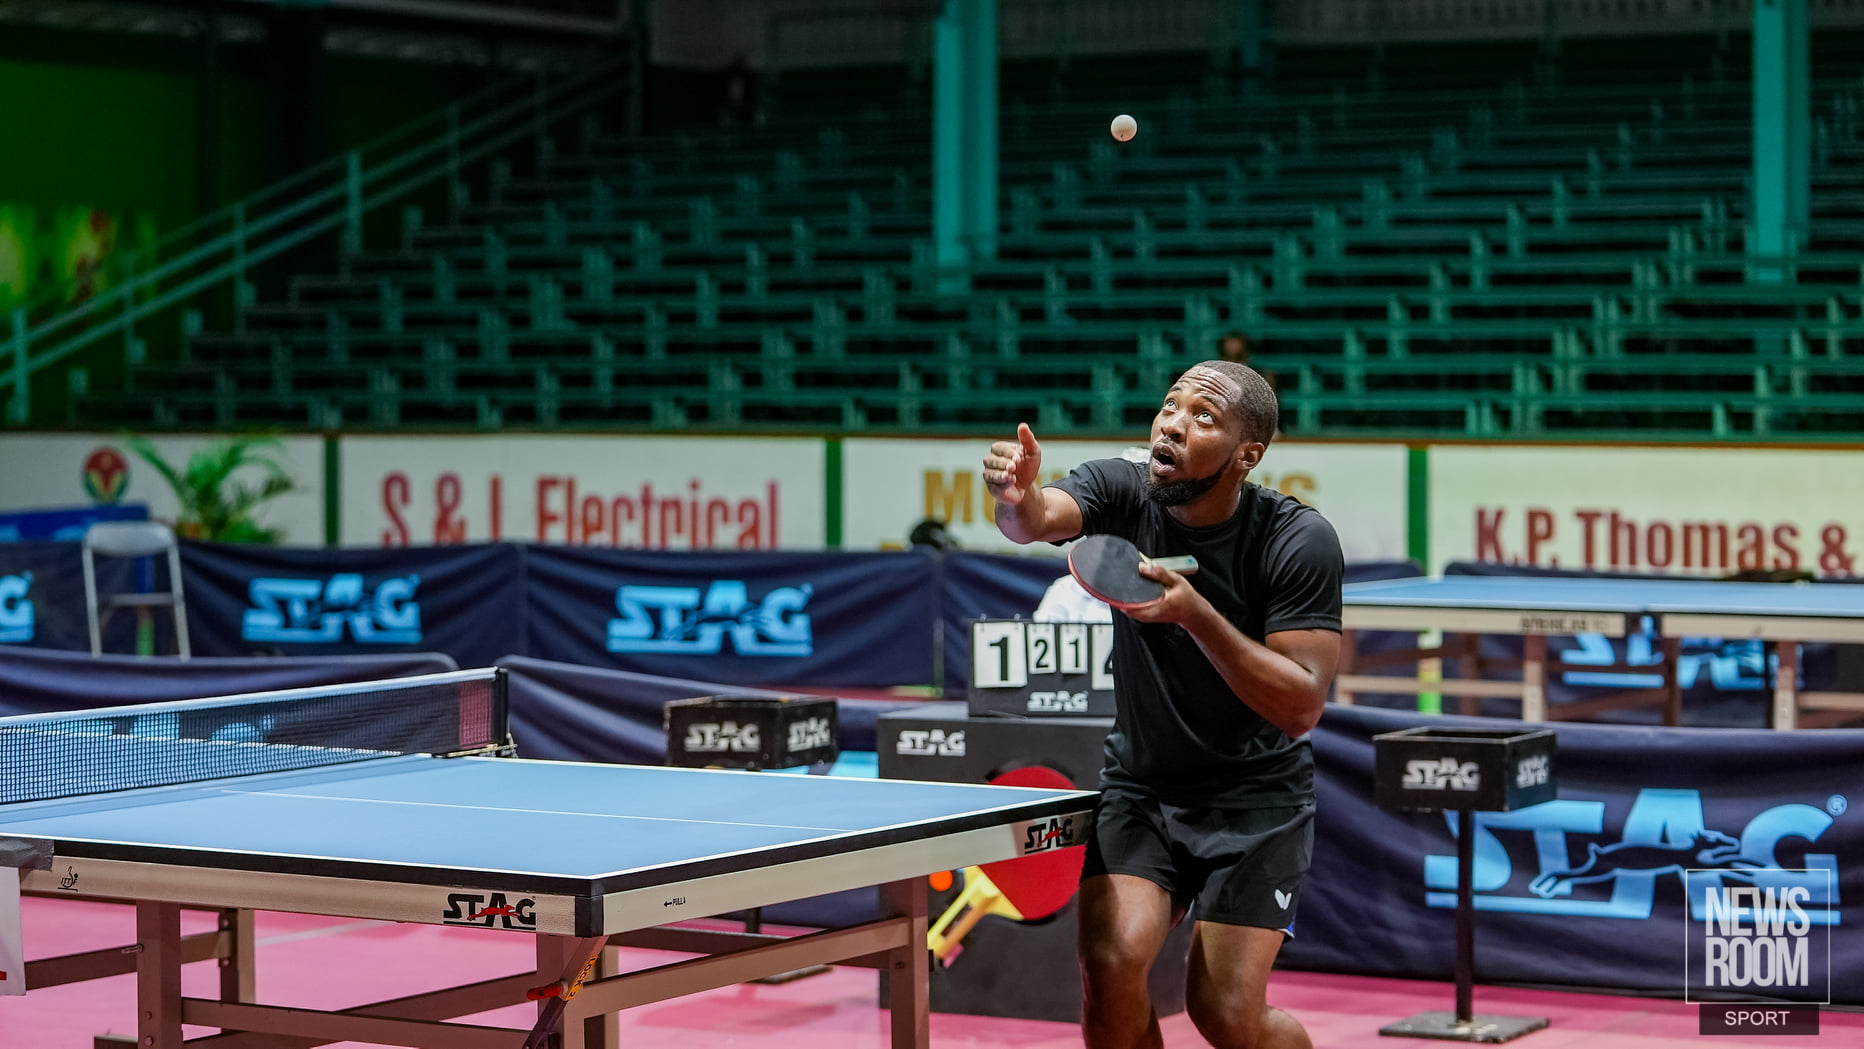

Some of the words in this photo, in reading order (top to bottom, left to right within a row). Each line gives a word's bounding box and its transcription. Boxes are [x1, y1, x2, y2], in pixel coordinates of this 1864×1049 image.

[380, 470, 411, 547] S
[434, 470, 467, 544] &
[536, 474, 779, 550] Electrical
[1575, 508, 1801, 571] Thomas
[1818, 522, 1855, 577] &
[242, 573, 422, 643] STAG
[607, 580, 813, 656] STAG
[989, 637, 1008, 681] 1
[1034, 639, 1049, 668] 2
[1068, 638, 1079, 668] 1
[1027, 691, 1088, 712] STAG
[684, 720, 760, 752] STAG
[896, 729, 965, 756] STAG
[1402, 757, 1480, 791] STAG
[1024, 817, 1074, 854] STAG
[443, 892, 537, 930] STAG
